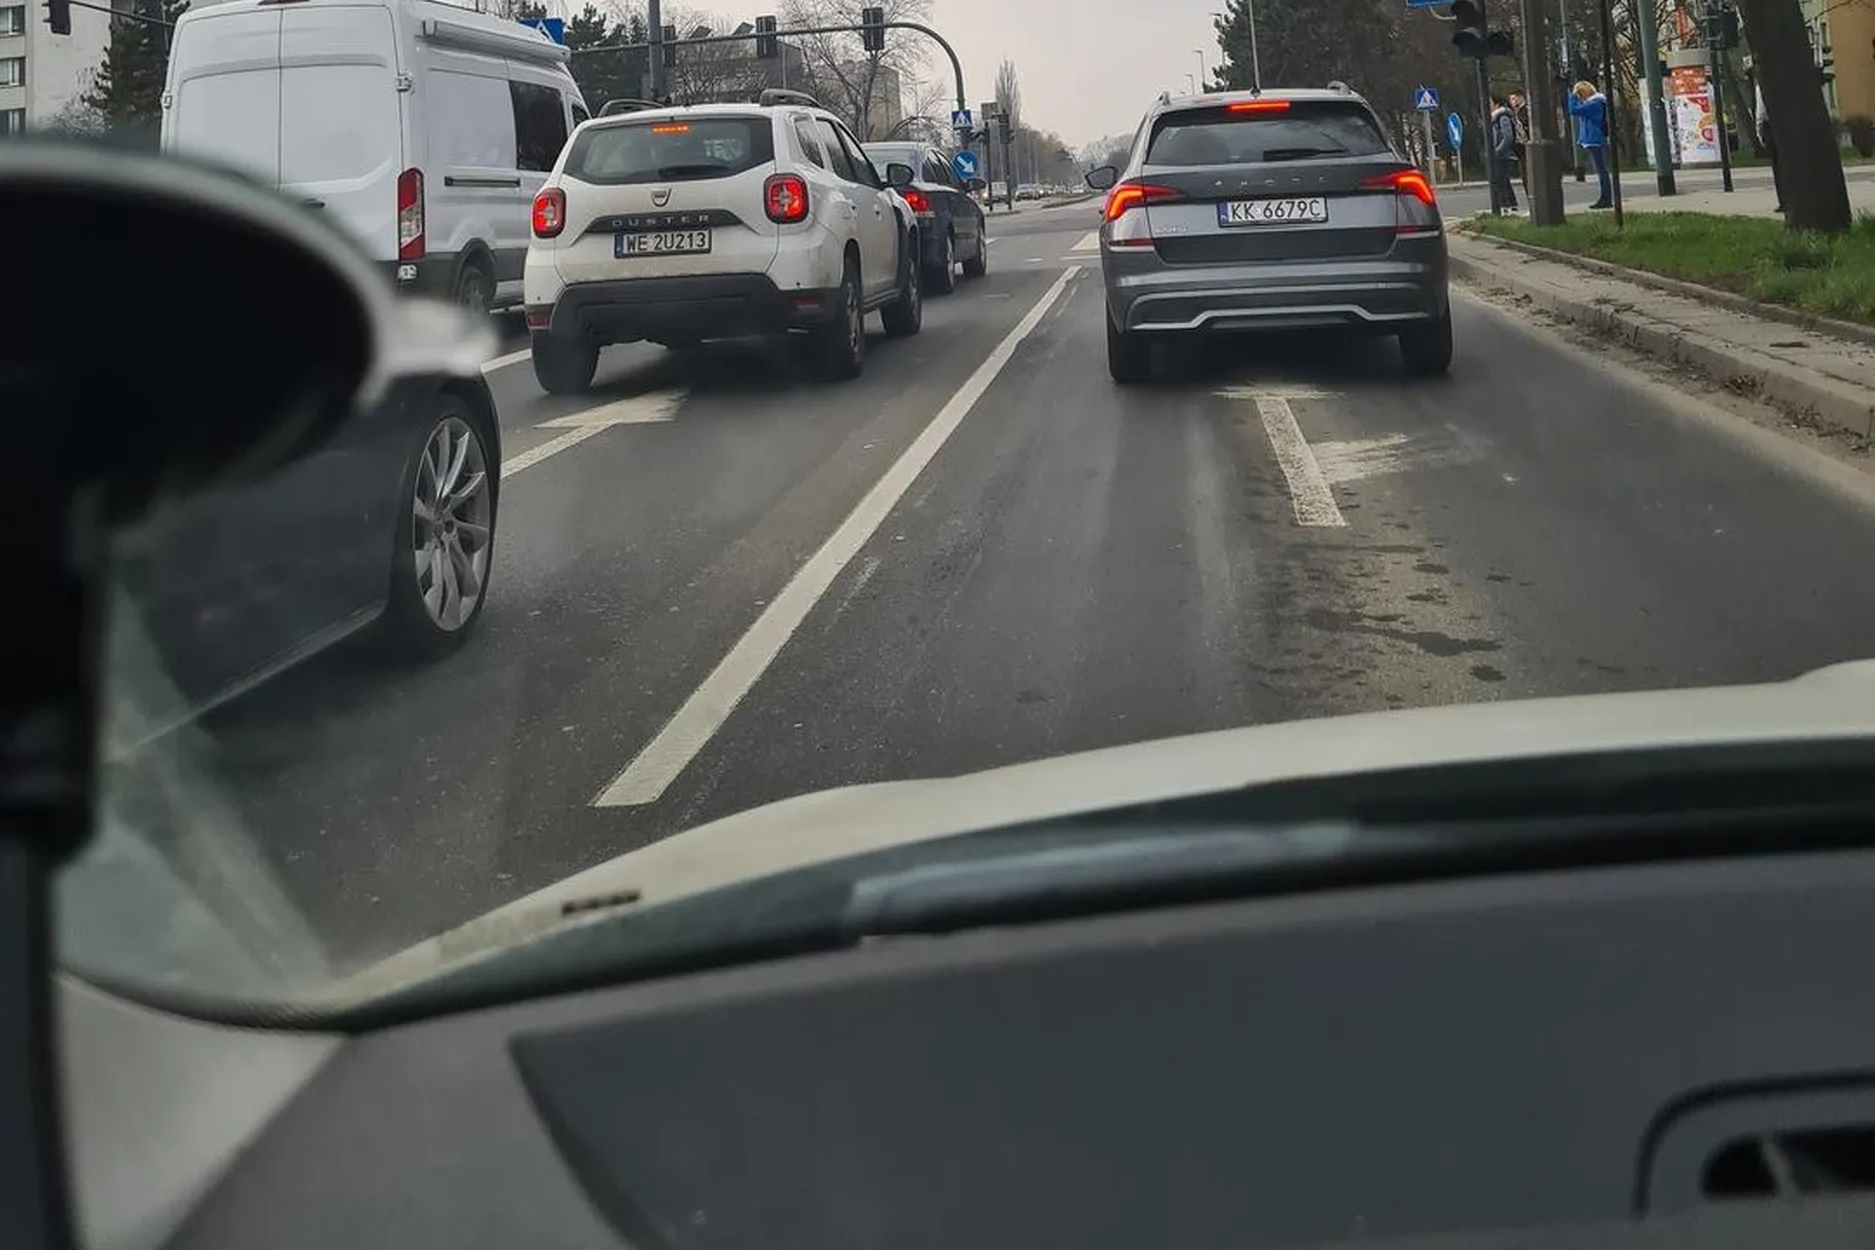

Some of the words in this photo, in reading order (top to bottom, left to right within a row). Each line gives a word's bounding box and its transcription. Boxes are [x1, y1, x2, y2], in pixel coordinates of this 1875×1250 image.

[1230, 203, 1255, 220] KK
[1262, 200, 1321, 219] 6679C
[626, 235, 648, 253] WE
[654, 232, 706, 251] 2U213
